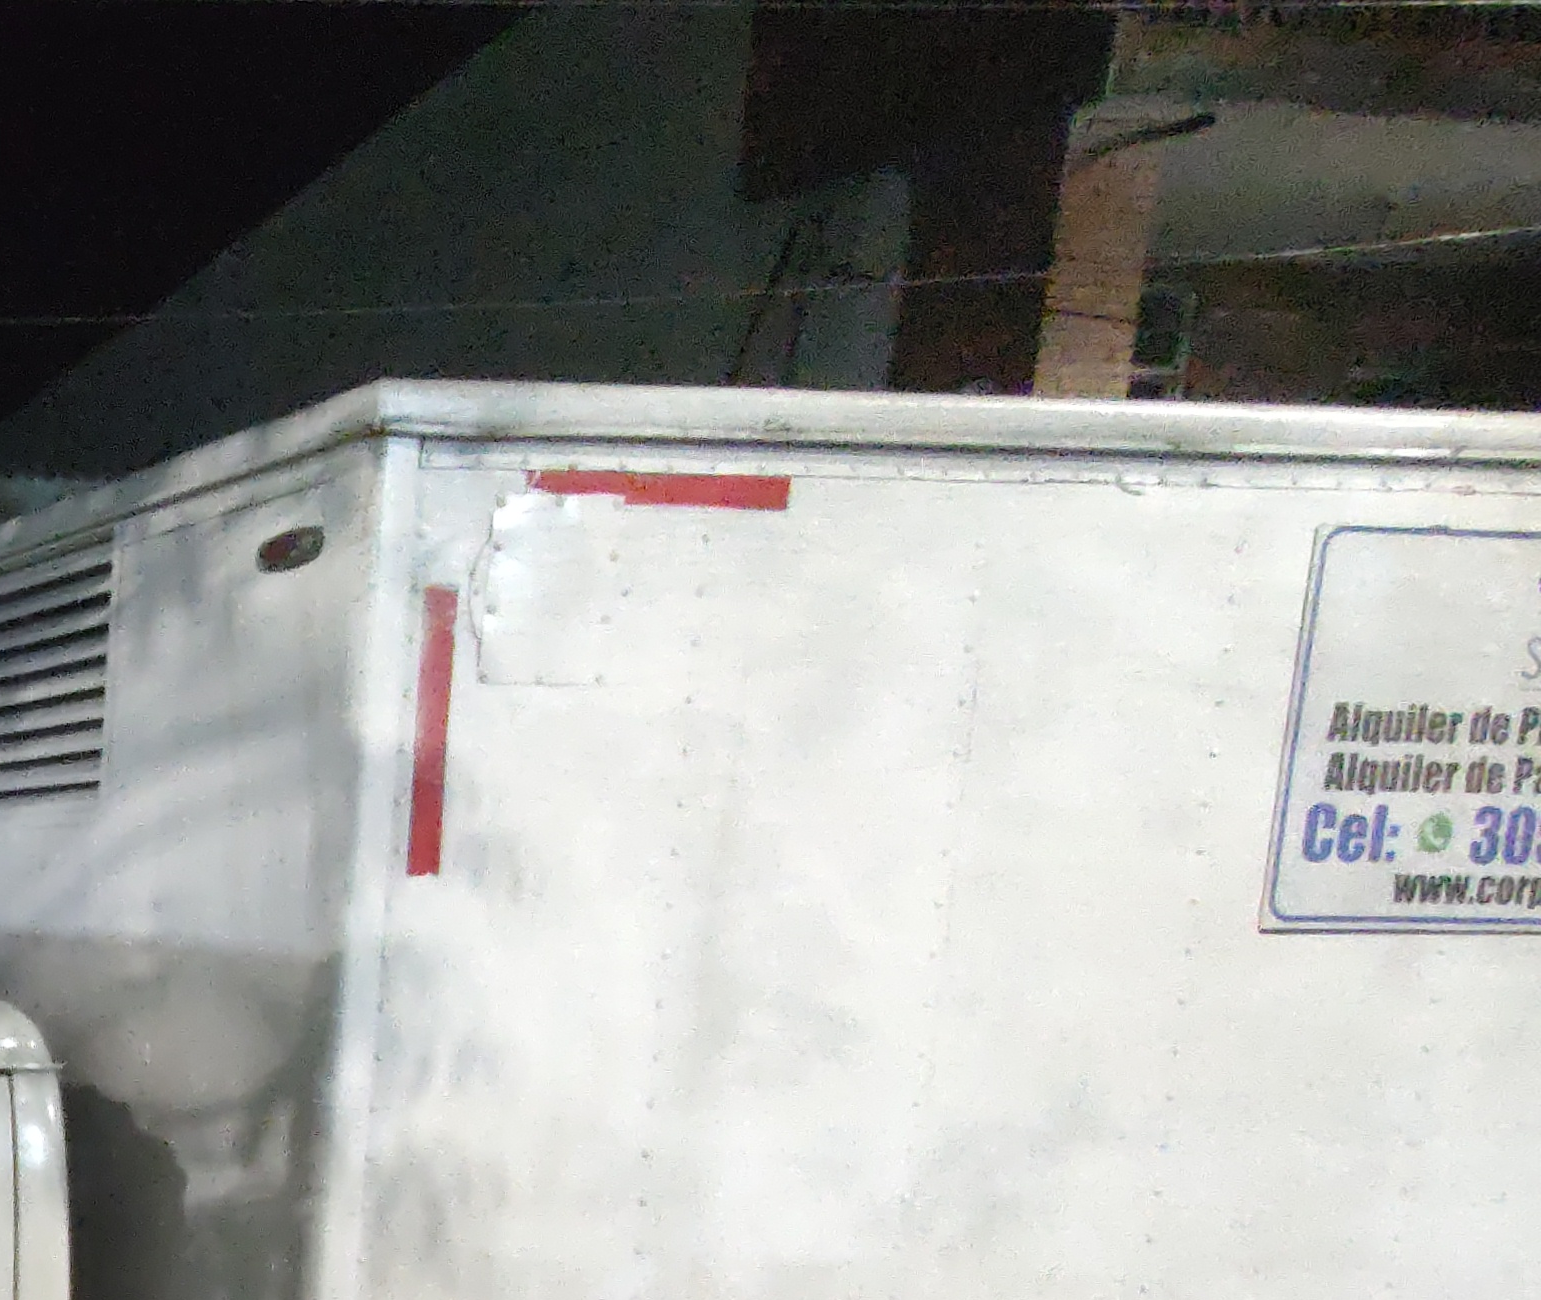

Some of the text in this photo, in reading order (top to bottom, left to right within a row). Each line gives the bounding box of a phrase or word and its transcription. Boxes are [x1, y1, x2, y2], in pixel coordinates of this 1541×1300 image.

[1326, 701, 1464, 747] Alquiler
[1469, 705, 1511, 746] de
[1323, 751, 1462, 795] Alquiler
[1464, 755, 1506, 795] de
[1301, 803, 1541, 866] Cel: 30
